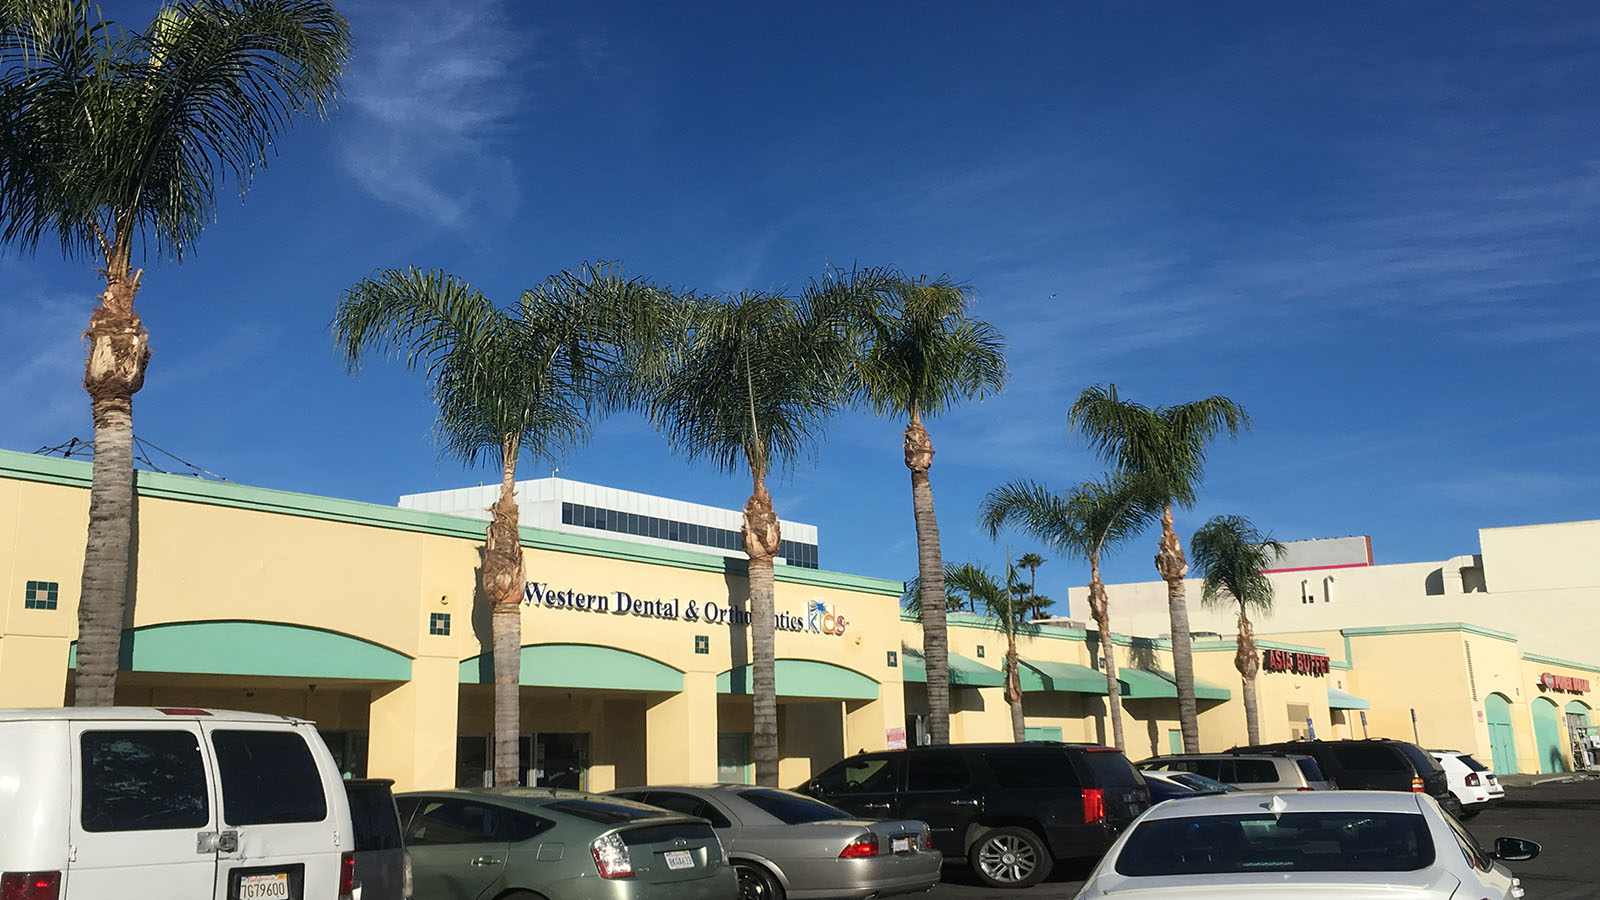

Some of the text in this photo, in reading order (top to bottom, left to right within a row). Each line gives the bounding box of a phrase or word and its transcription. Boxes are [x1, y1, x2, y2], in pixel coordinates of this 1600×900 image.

[524, 581, 804, 630] Western Dental & Orthontics
[807, 600, 845, 635] kids
[1269, 650, 1331, 674] ASIA BUFFET
[241, 882, 285, 898] 7G79600
